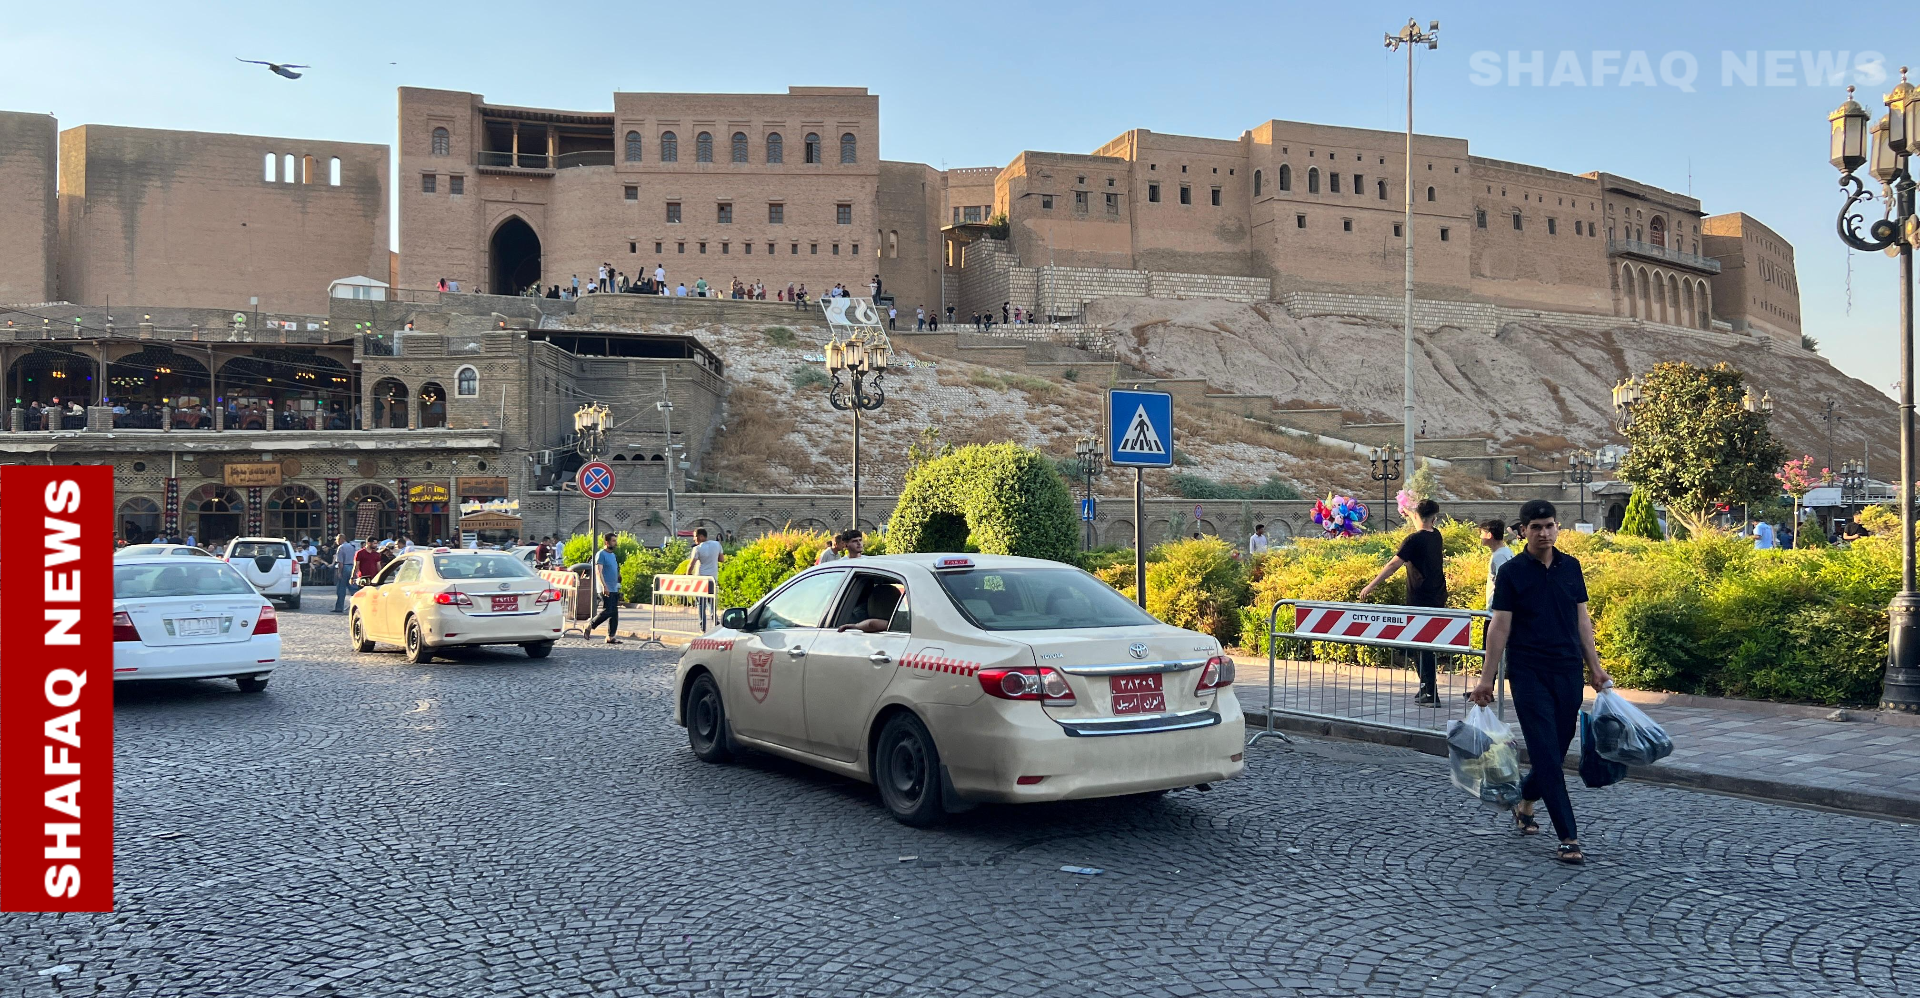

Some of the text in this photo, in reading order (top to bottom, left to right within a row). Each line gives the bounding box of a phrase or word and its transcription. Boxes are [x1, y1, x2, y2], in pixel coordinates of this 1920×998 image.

[1352, 613, 1369, 621] CITY
[1382, 616, 1404, 624] ERBIL
[1040, 652, 1064, 660] TOYOTA
[1120, 677, 1155, 690] ٣٨٣٠٩
[1116, 698, 1137, 710] اربيل
